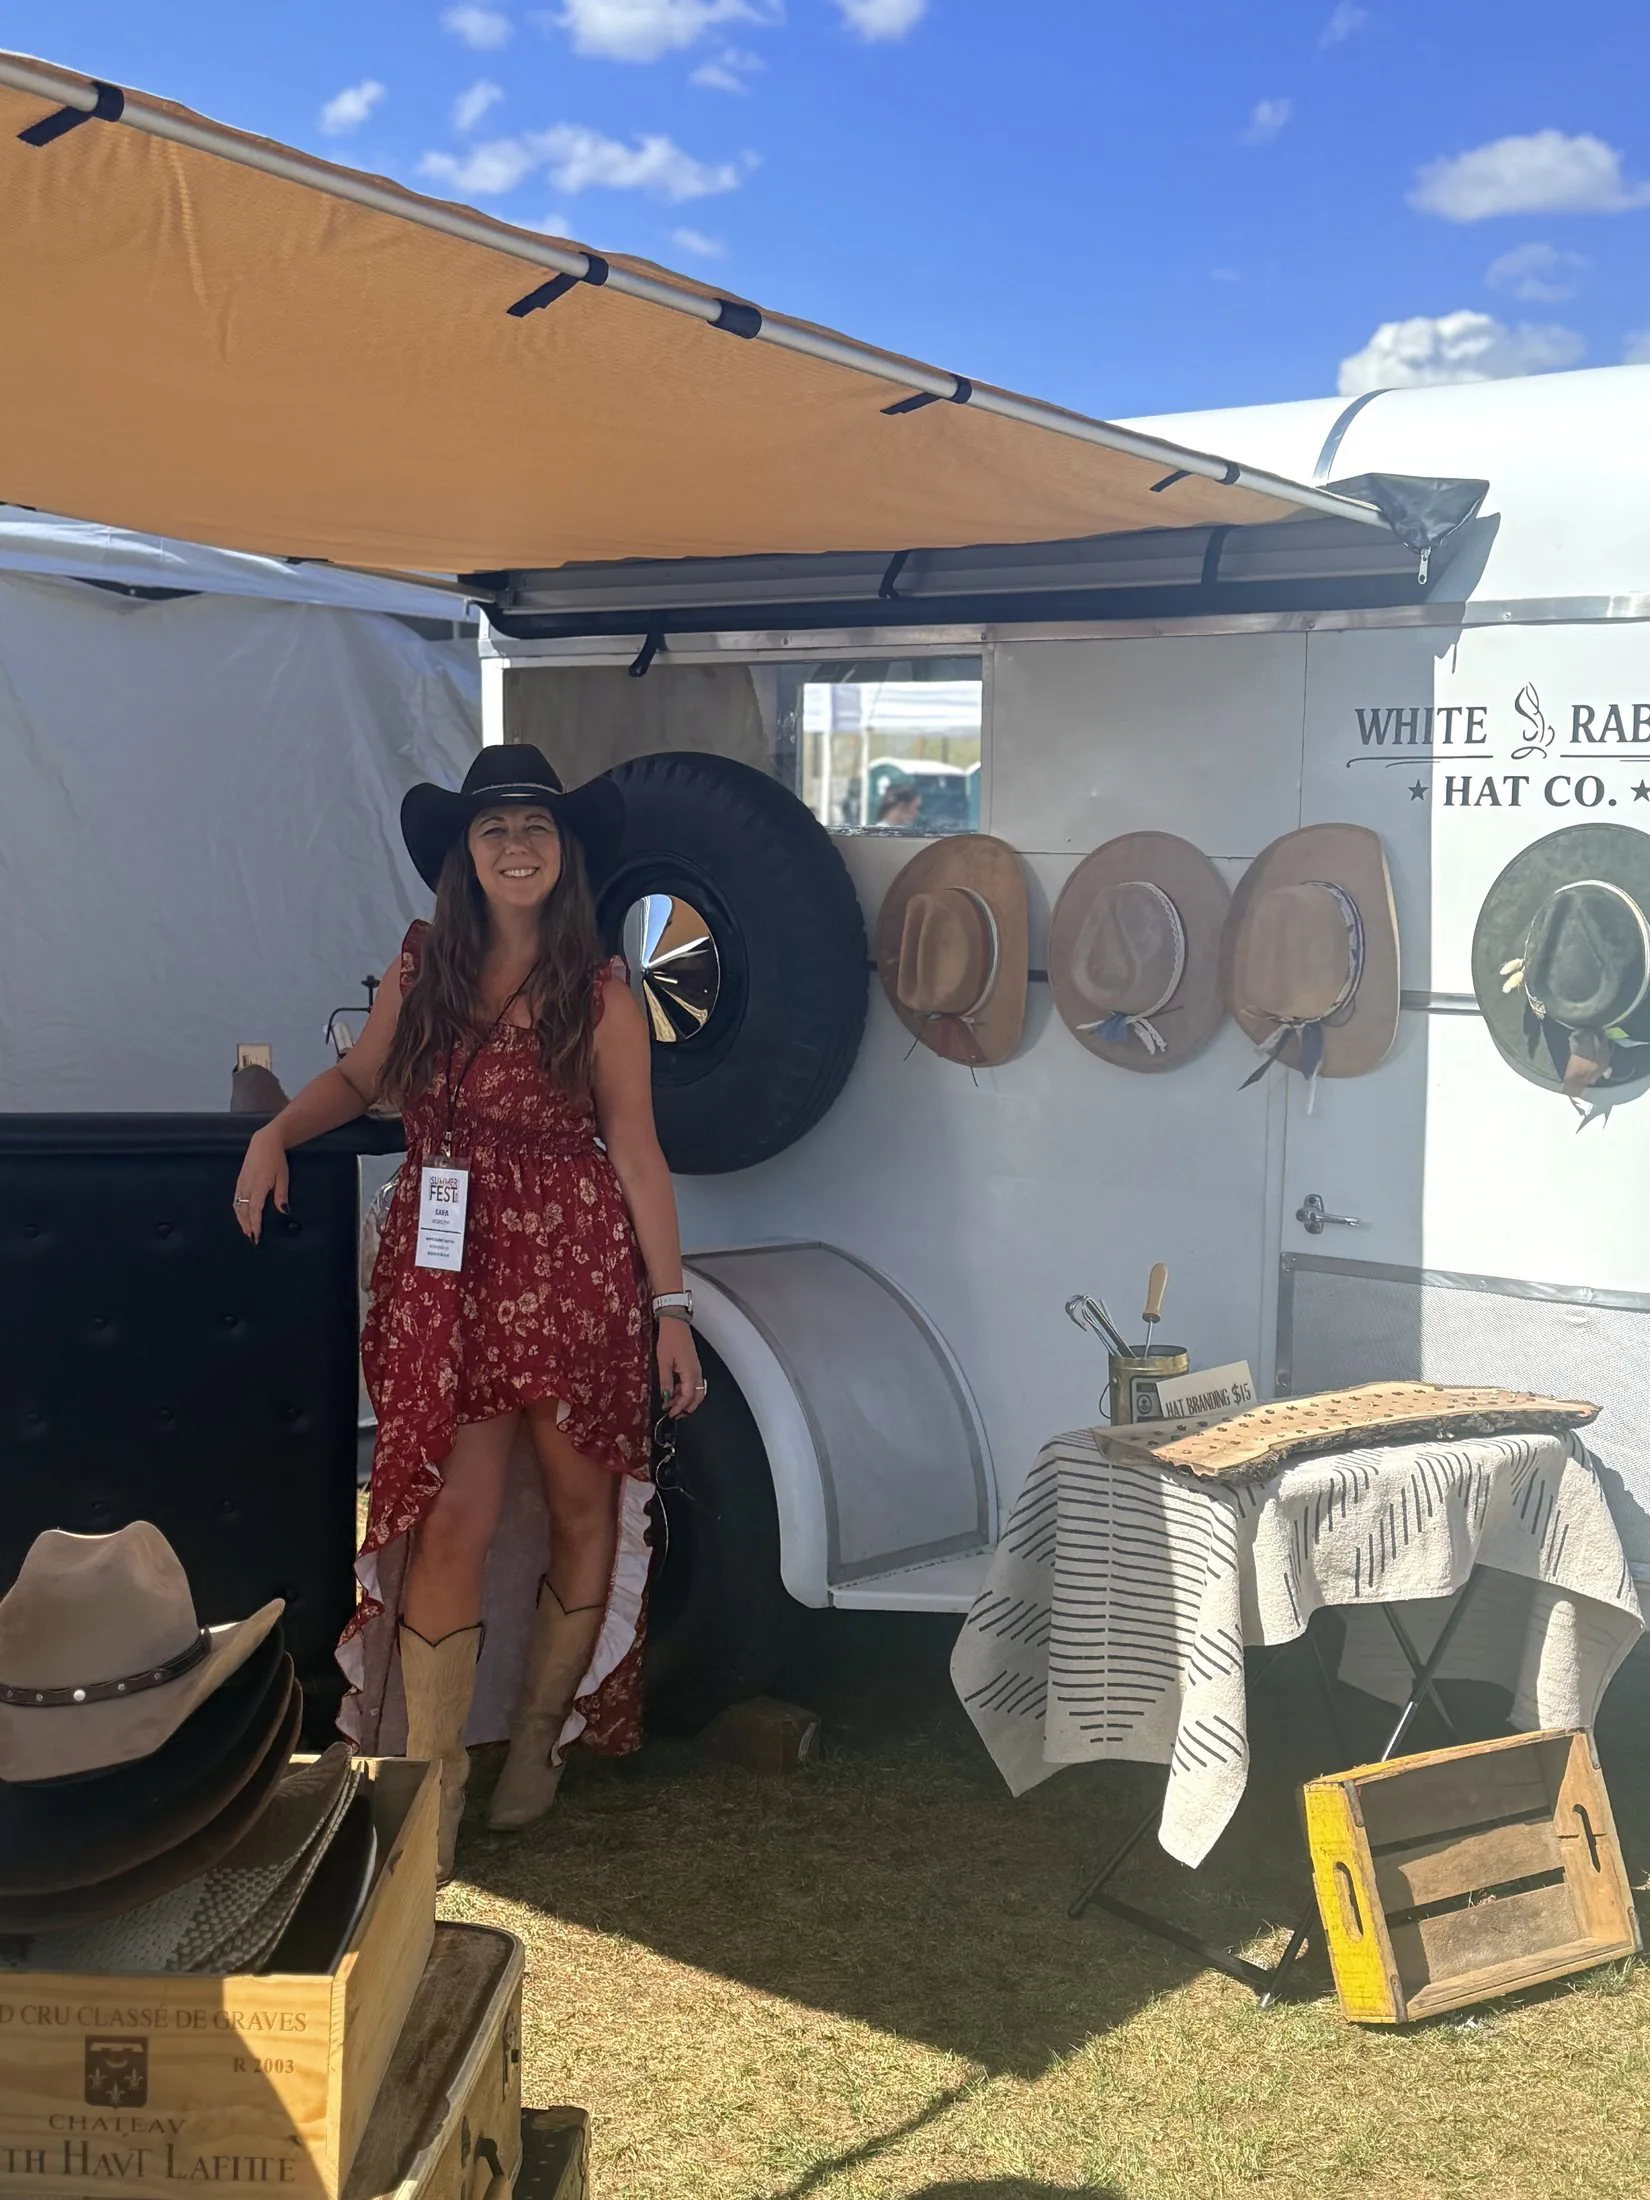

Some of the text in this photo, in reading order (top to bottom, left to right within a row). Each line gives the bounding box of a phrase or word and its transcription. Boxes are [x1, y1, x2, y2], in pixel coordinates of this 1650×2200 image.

[1354, 703, 1650, 745] WHITE RAB
[1444, 775, 1617, 807] HAT CO.
[429, 1184, 458, 1203] FEST
[1166, 1382, 1251, 1418] HAT BRANDING $15
[20, 2005, 71, 2026] CRU
[77, 2004, 168, 2029] CLASSÉ
[176, 2009, 206, 2029] DE
[212, 2010, 307, 2032] GRAVES
[233, 2057, 295, 2074] R 2003
[165, 2143, 297, 2182] LAFITTE
